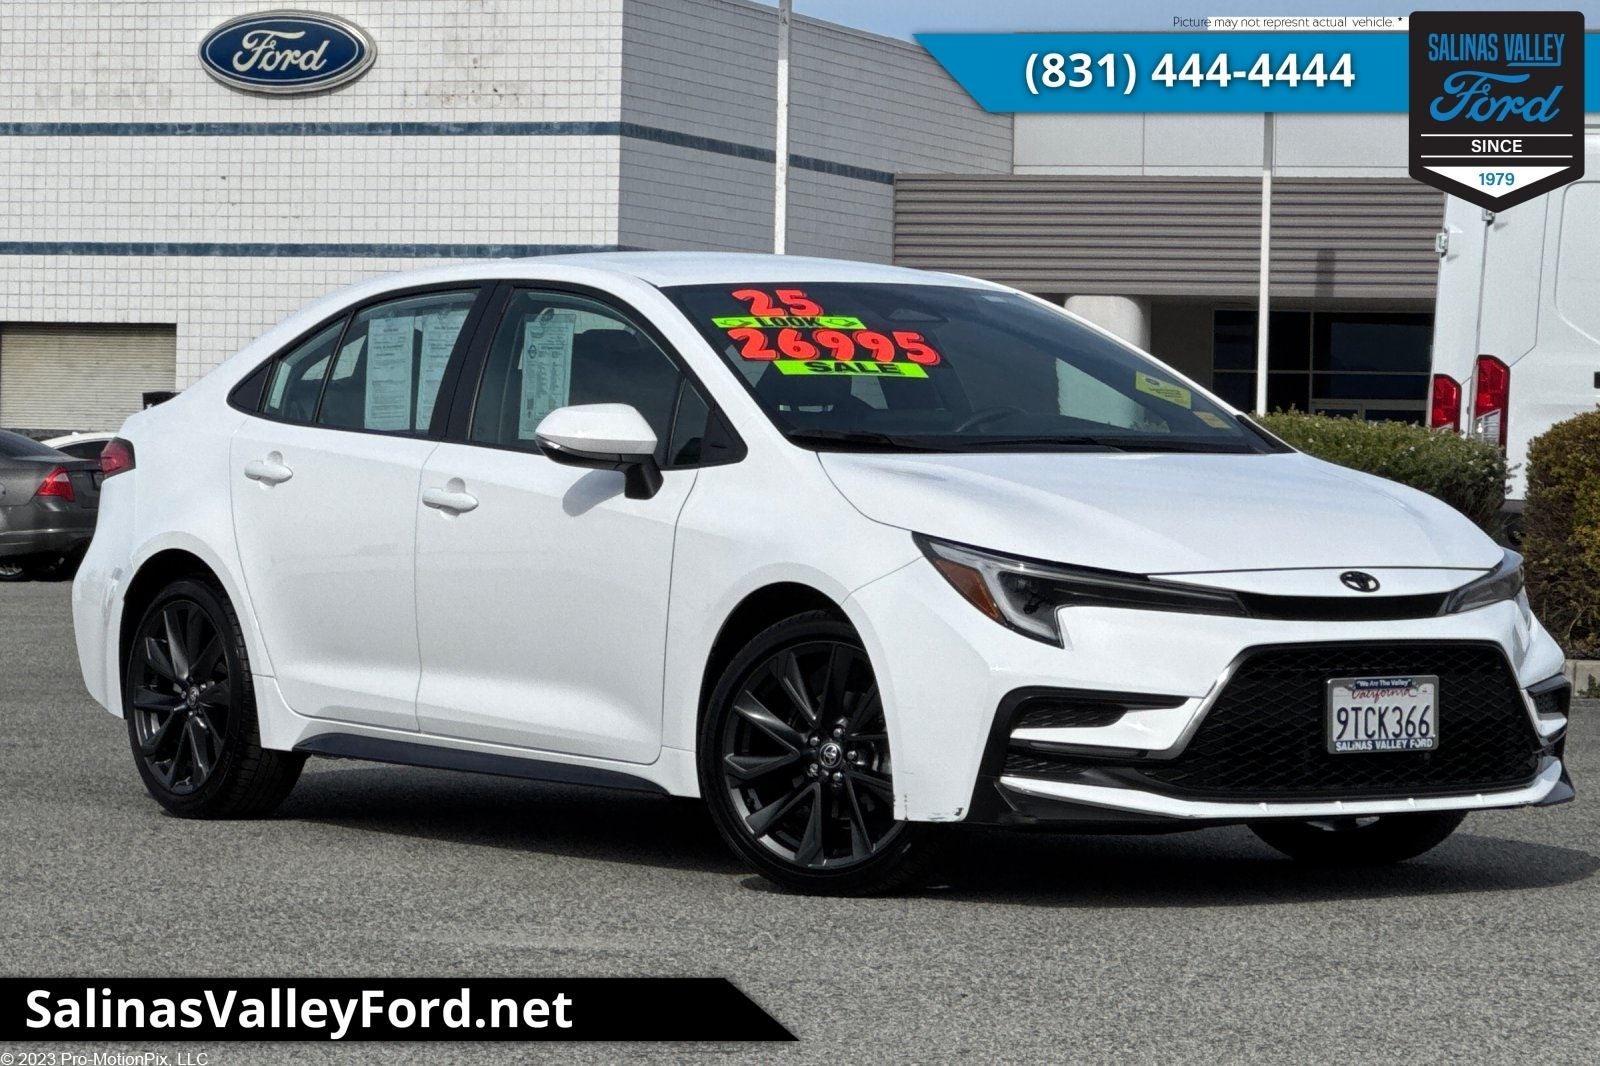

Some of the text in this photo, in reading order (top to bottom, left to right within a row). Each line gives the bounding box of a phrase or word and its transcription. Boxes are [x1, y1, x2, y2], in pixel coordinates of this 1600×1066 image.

[232, 30, 331, 72] Ford
[731, 288, 823, 316] 25
[758, 316, 822, 327] LOOK
[727, 327, 941, 366] 26995
[803, 361, 906, 376] SALE
[1352, 688, 1417, 703] California
[1336, 705, 1431, 740] 9TCK366
[1335, 738, 1433, 751] SALINAS VALLEY FORD
